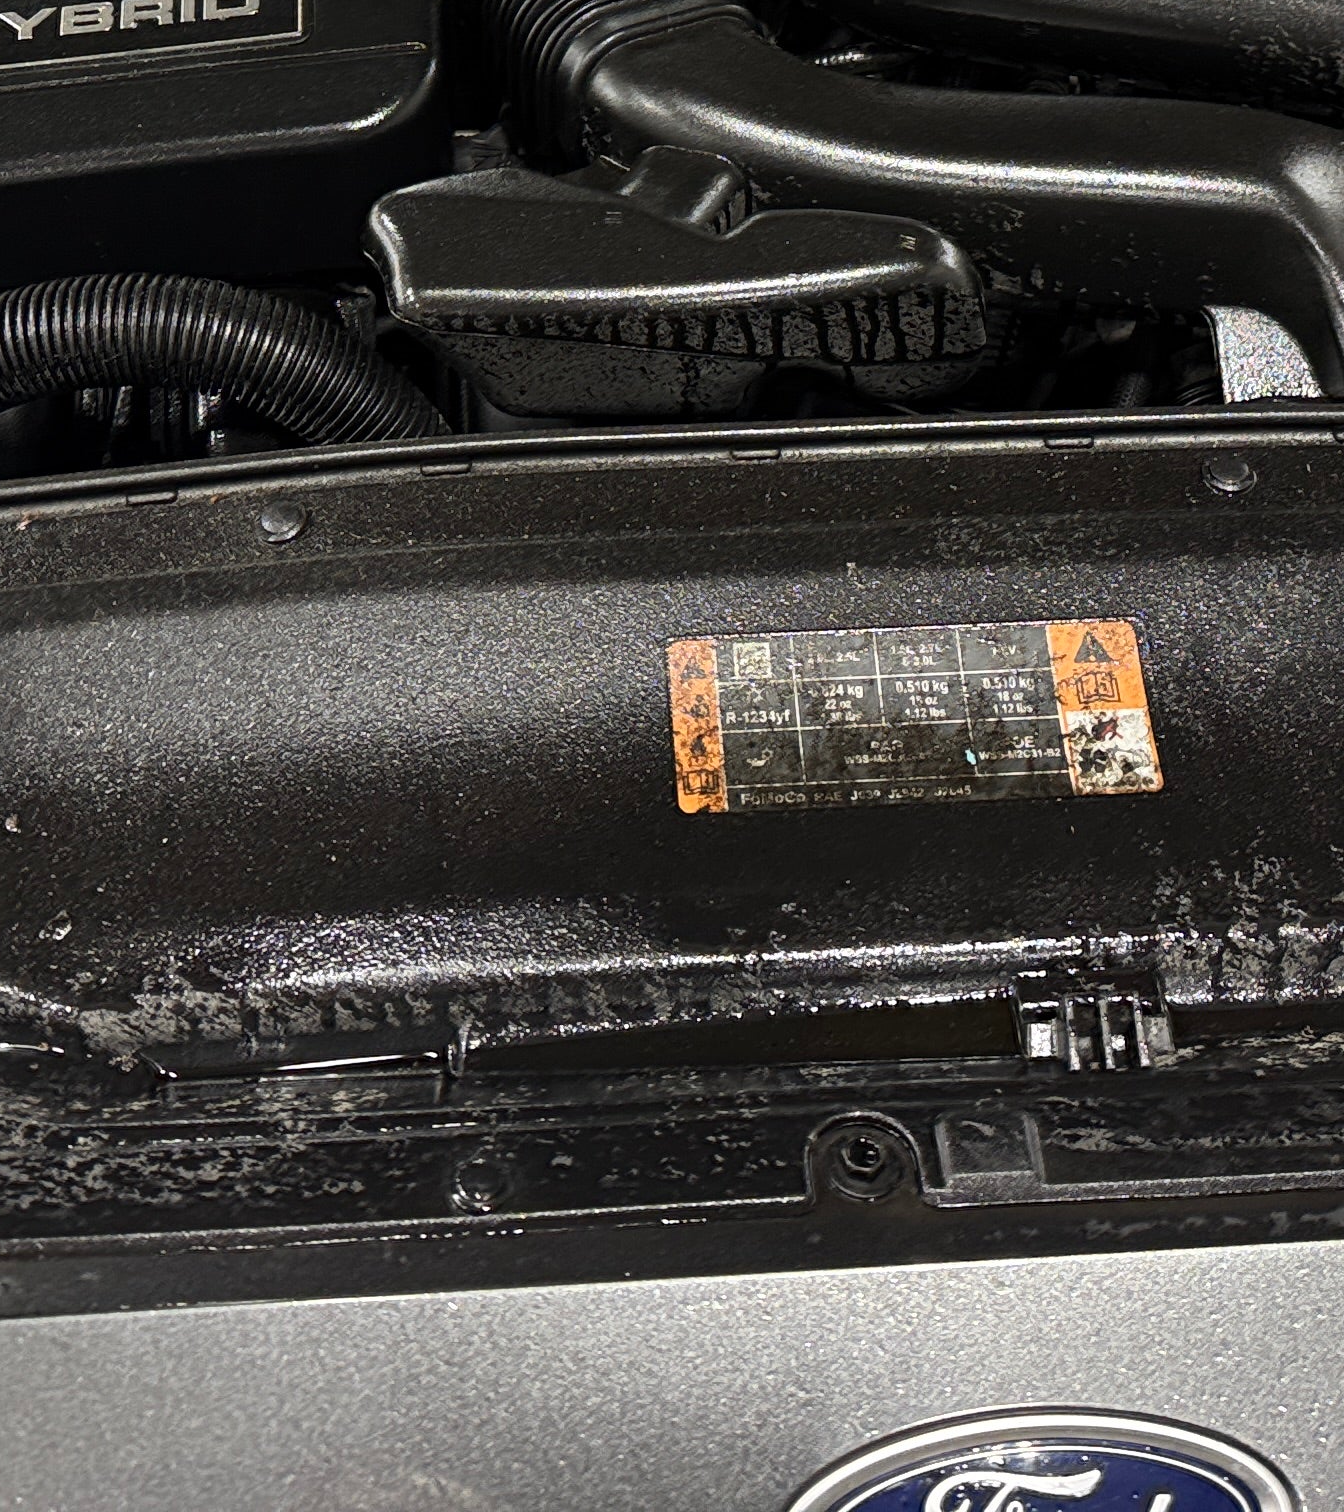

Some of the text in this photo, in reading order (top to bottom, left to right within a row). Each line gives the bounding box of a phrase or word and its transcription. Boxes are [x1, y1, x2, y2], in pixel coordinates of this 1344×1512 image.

[847, 682, 864, 699] kg
[895, 679, 949, 695] 0.510 kg
[982, 675, 1036, 691] 0.510 kg
[824, 699, 837, 710] 22
[997, 691, 1010, 702] 18
[725, 710, 790, 728] R-1234yf
[904, 706, 947, 719] 1.12 lbs
